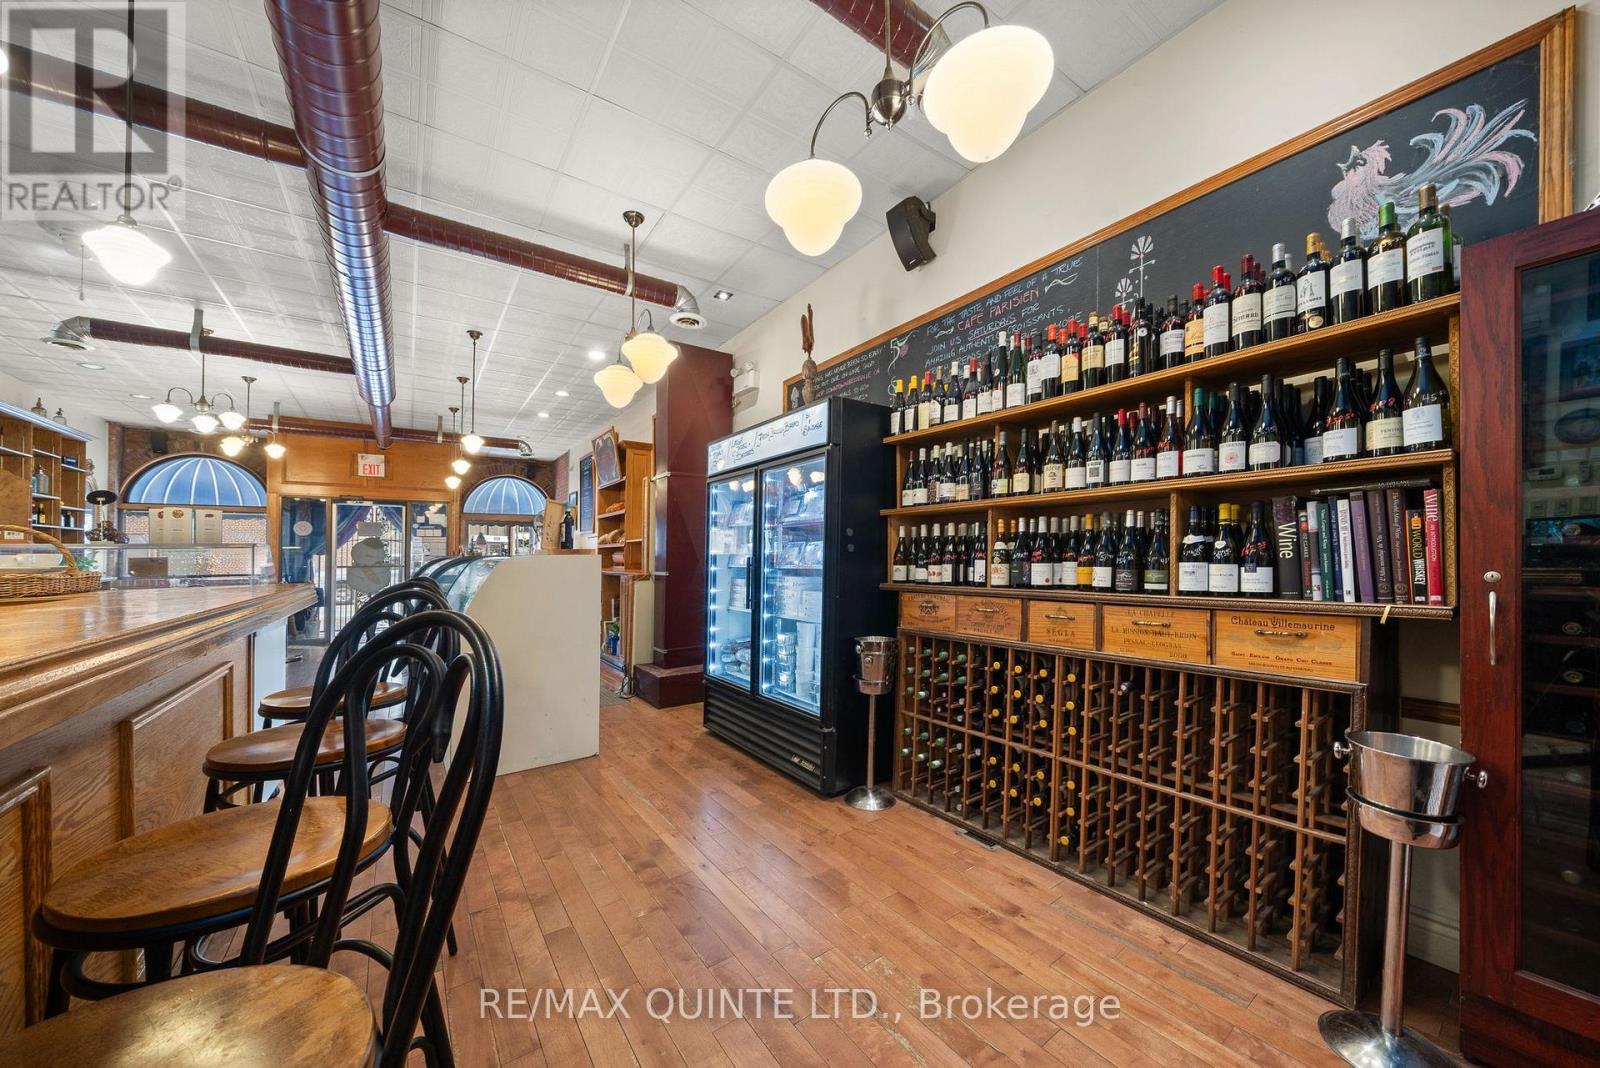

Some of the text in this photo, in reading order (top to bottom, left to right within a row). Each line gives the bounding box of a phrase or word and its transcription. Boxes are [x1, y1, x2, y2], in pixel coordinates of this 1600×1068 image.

[958, 301, 985, 319] TASTE
[986, 293, 1003, 308] AND
[1003, 283, 1024, 299] FEEL
[1026, 277, 1037, 289] OF
[1042, 273, 1048, 283] A
[1050, 256, 1083, 275] TRUE
[989, 287, 1040, 319] PARISIEN
[928, 341, 946, 356] JOIN
[950, 335, 962, 346] US
[968, 312, 1017, 341] SATURDAYS
[1021, 302, 1040, 318] FOR
[925, 348, 956, 369] AMAZING
[363, 463, 381, 475] EXIT
[1278, 521, 1297, 559] Wine
[1412, 530, 1423, 559] WORLD
[1413, 558, 1426, 585] WHISKEY
[1231, 615, 1336, 632] Château Villemaurine
